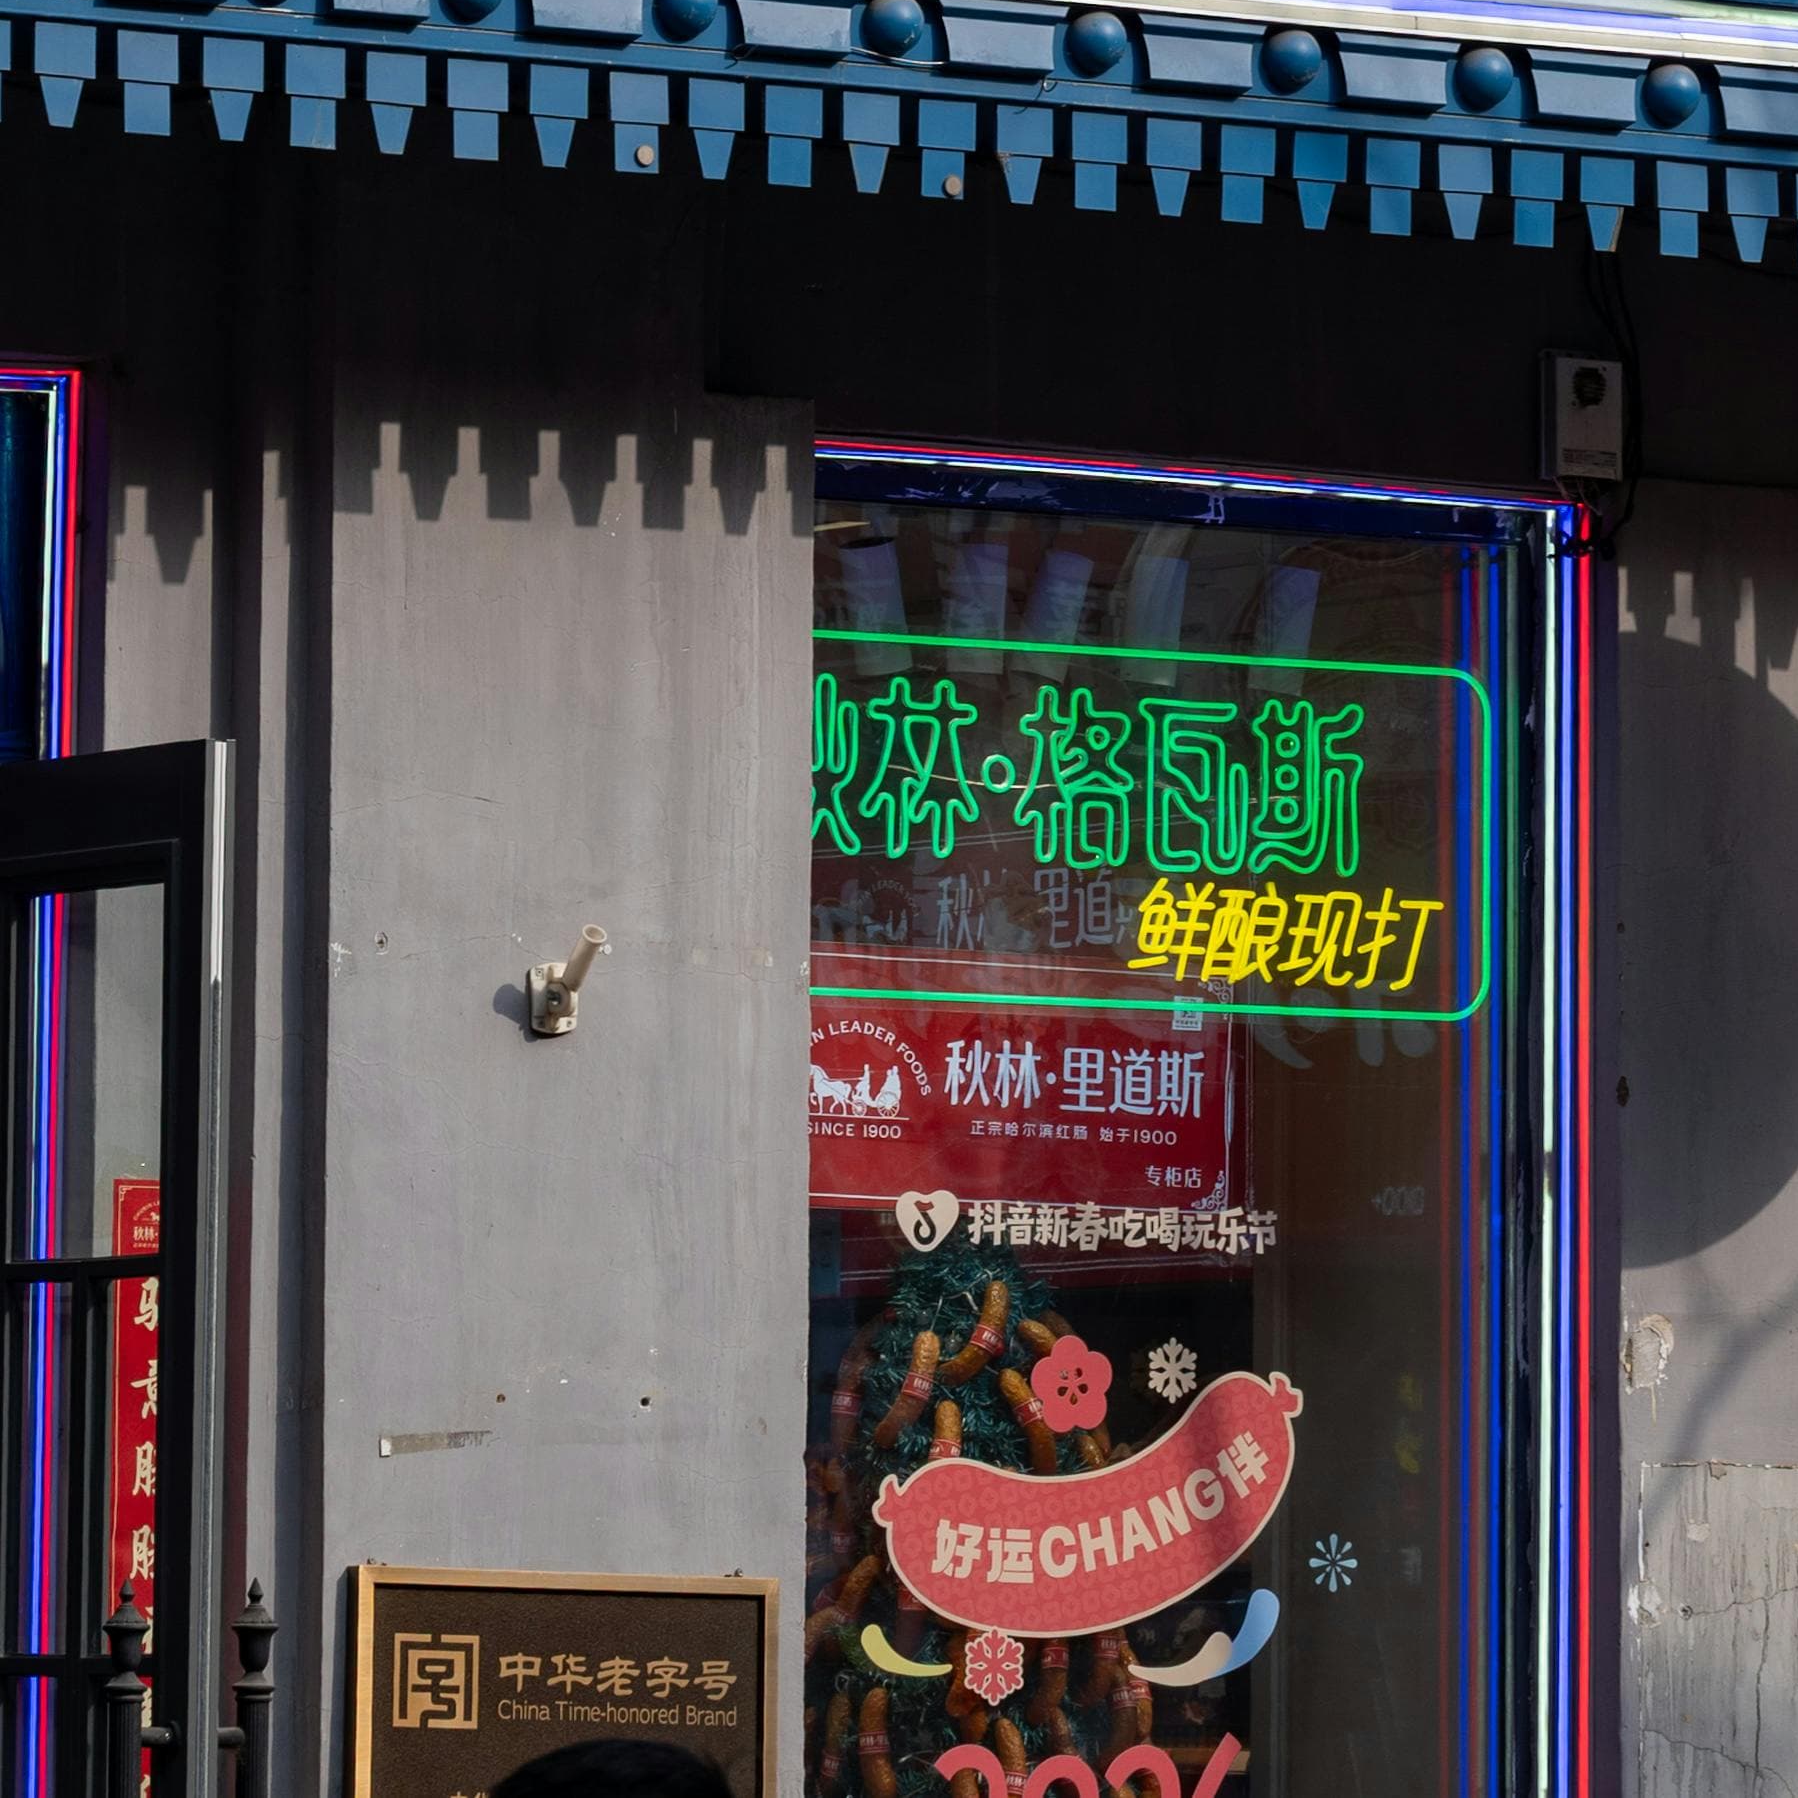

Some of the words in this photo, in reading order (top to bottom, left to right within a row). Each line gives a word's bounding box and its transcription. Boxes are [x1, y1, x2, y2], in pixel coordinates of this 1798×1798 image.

[1127, 876, 1444, 991] 鲜酿现打
[828, 1020, 896, 1046] LEADER
[896, 1042, 932, 1096] FOODS
[943, 1038, 1206, 1119] 秋林·里道斯
[863, 1124, 902, 1139] 1900
[969, 1119, 1089, 1141] 正宗哈尔滨红肠
[1098, 1127, 1178, 1146] 始于1900
[1144, 1164, 1203, 1189] 专柜店
[967, 1200, 1278, 1256] 抖音新春吃喝玩乐节
[498, 1651, 738, 1702] 中华老字号
[497, 1699, 552, 1722] China
[554, 1701, 679, 1726] Time-honored
[685, 1704, 738, 1728] Brand
